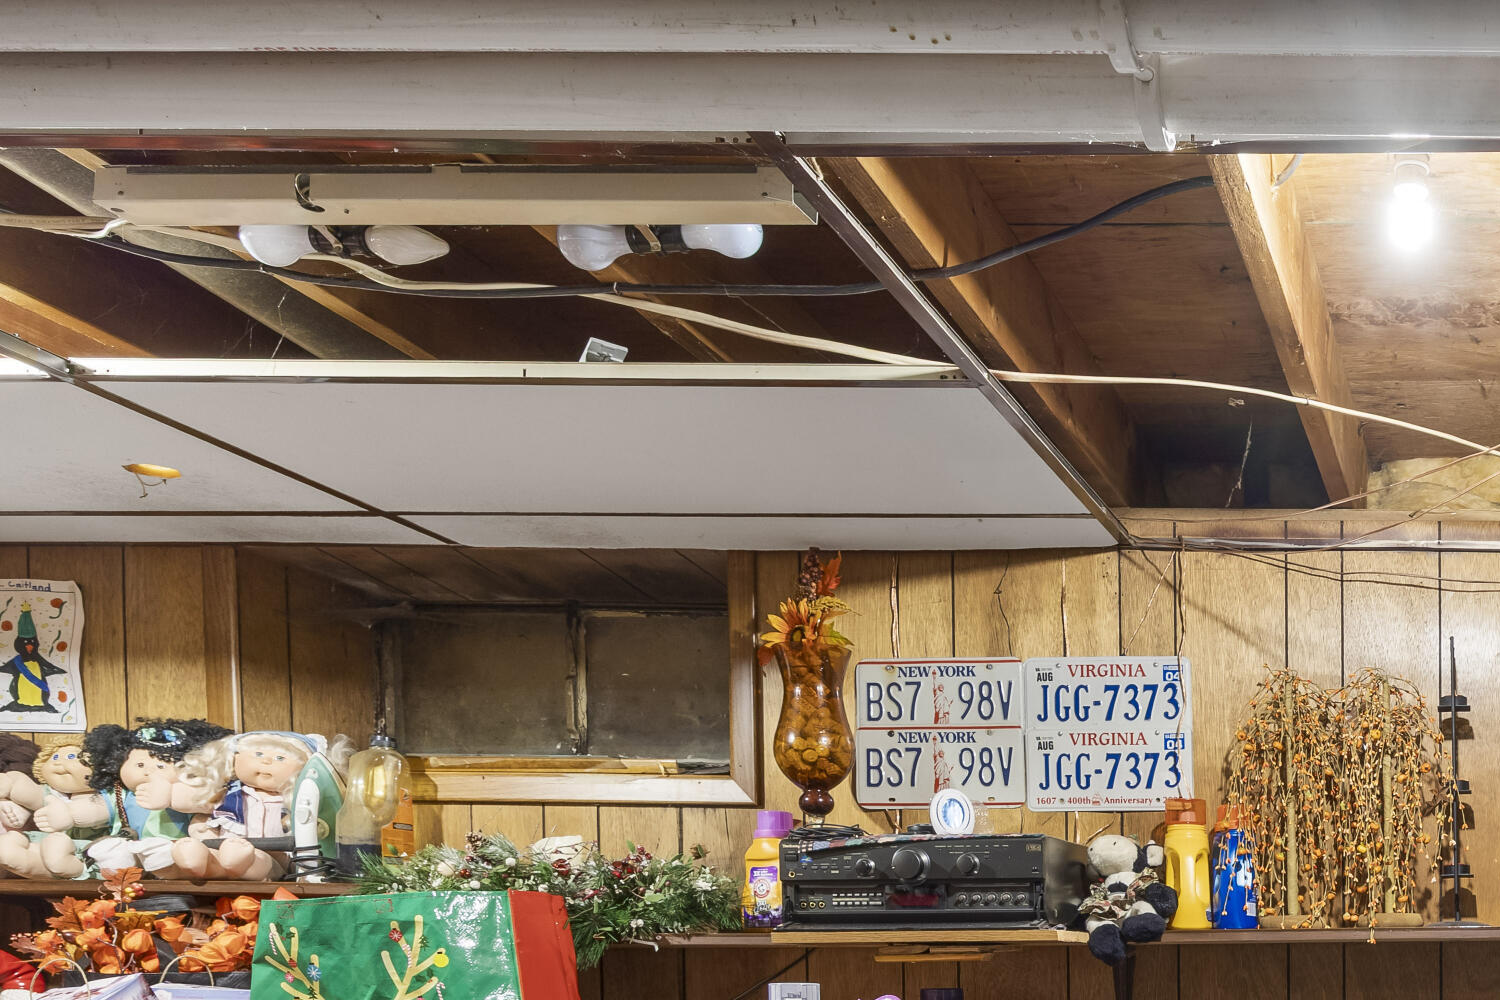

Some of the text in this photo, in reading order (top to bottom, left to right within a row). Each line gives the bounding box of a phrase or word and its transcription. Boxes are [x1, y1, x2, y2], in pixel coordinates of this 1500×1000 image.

[898, 665, 976, 677] NEW YORK
[1036, 672, 1053, 682] AUG
[1068, 664, 1146, 677] VIRGINIA
[866, 680, 1013, 721] BS7 98V
[1036, 683, 1180, 722] JGG-7373
[898, 731, 976, 743] NEW YORK
[1069, 732, 1148, 745] VIRGINIA
[1037, 741, 1054, 750] AUG
[866, 747, 1013, 787] BS7 98V
[1039, 751, 1181, 790] JGG-7373
[1067, 796, 1091, 804] 400th
[1104, 796, 1153, 805] Anniversary
